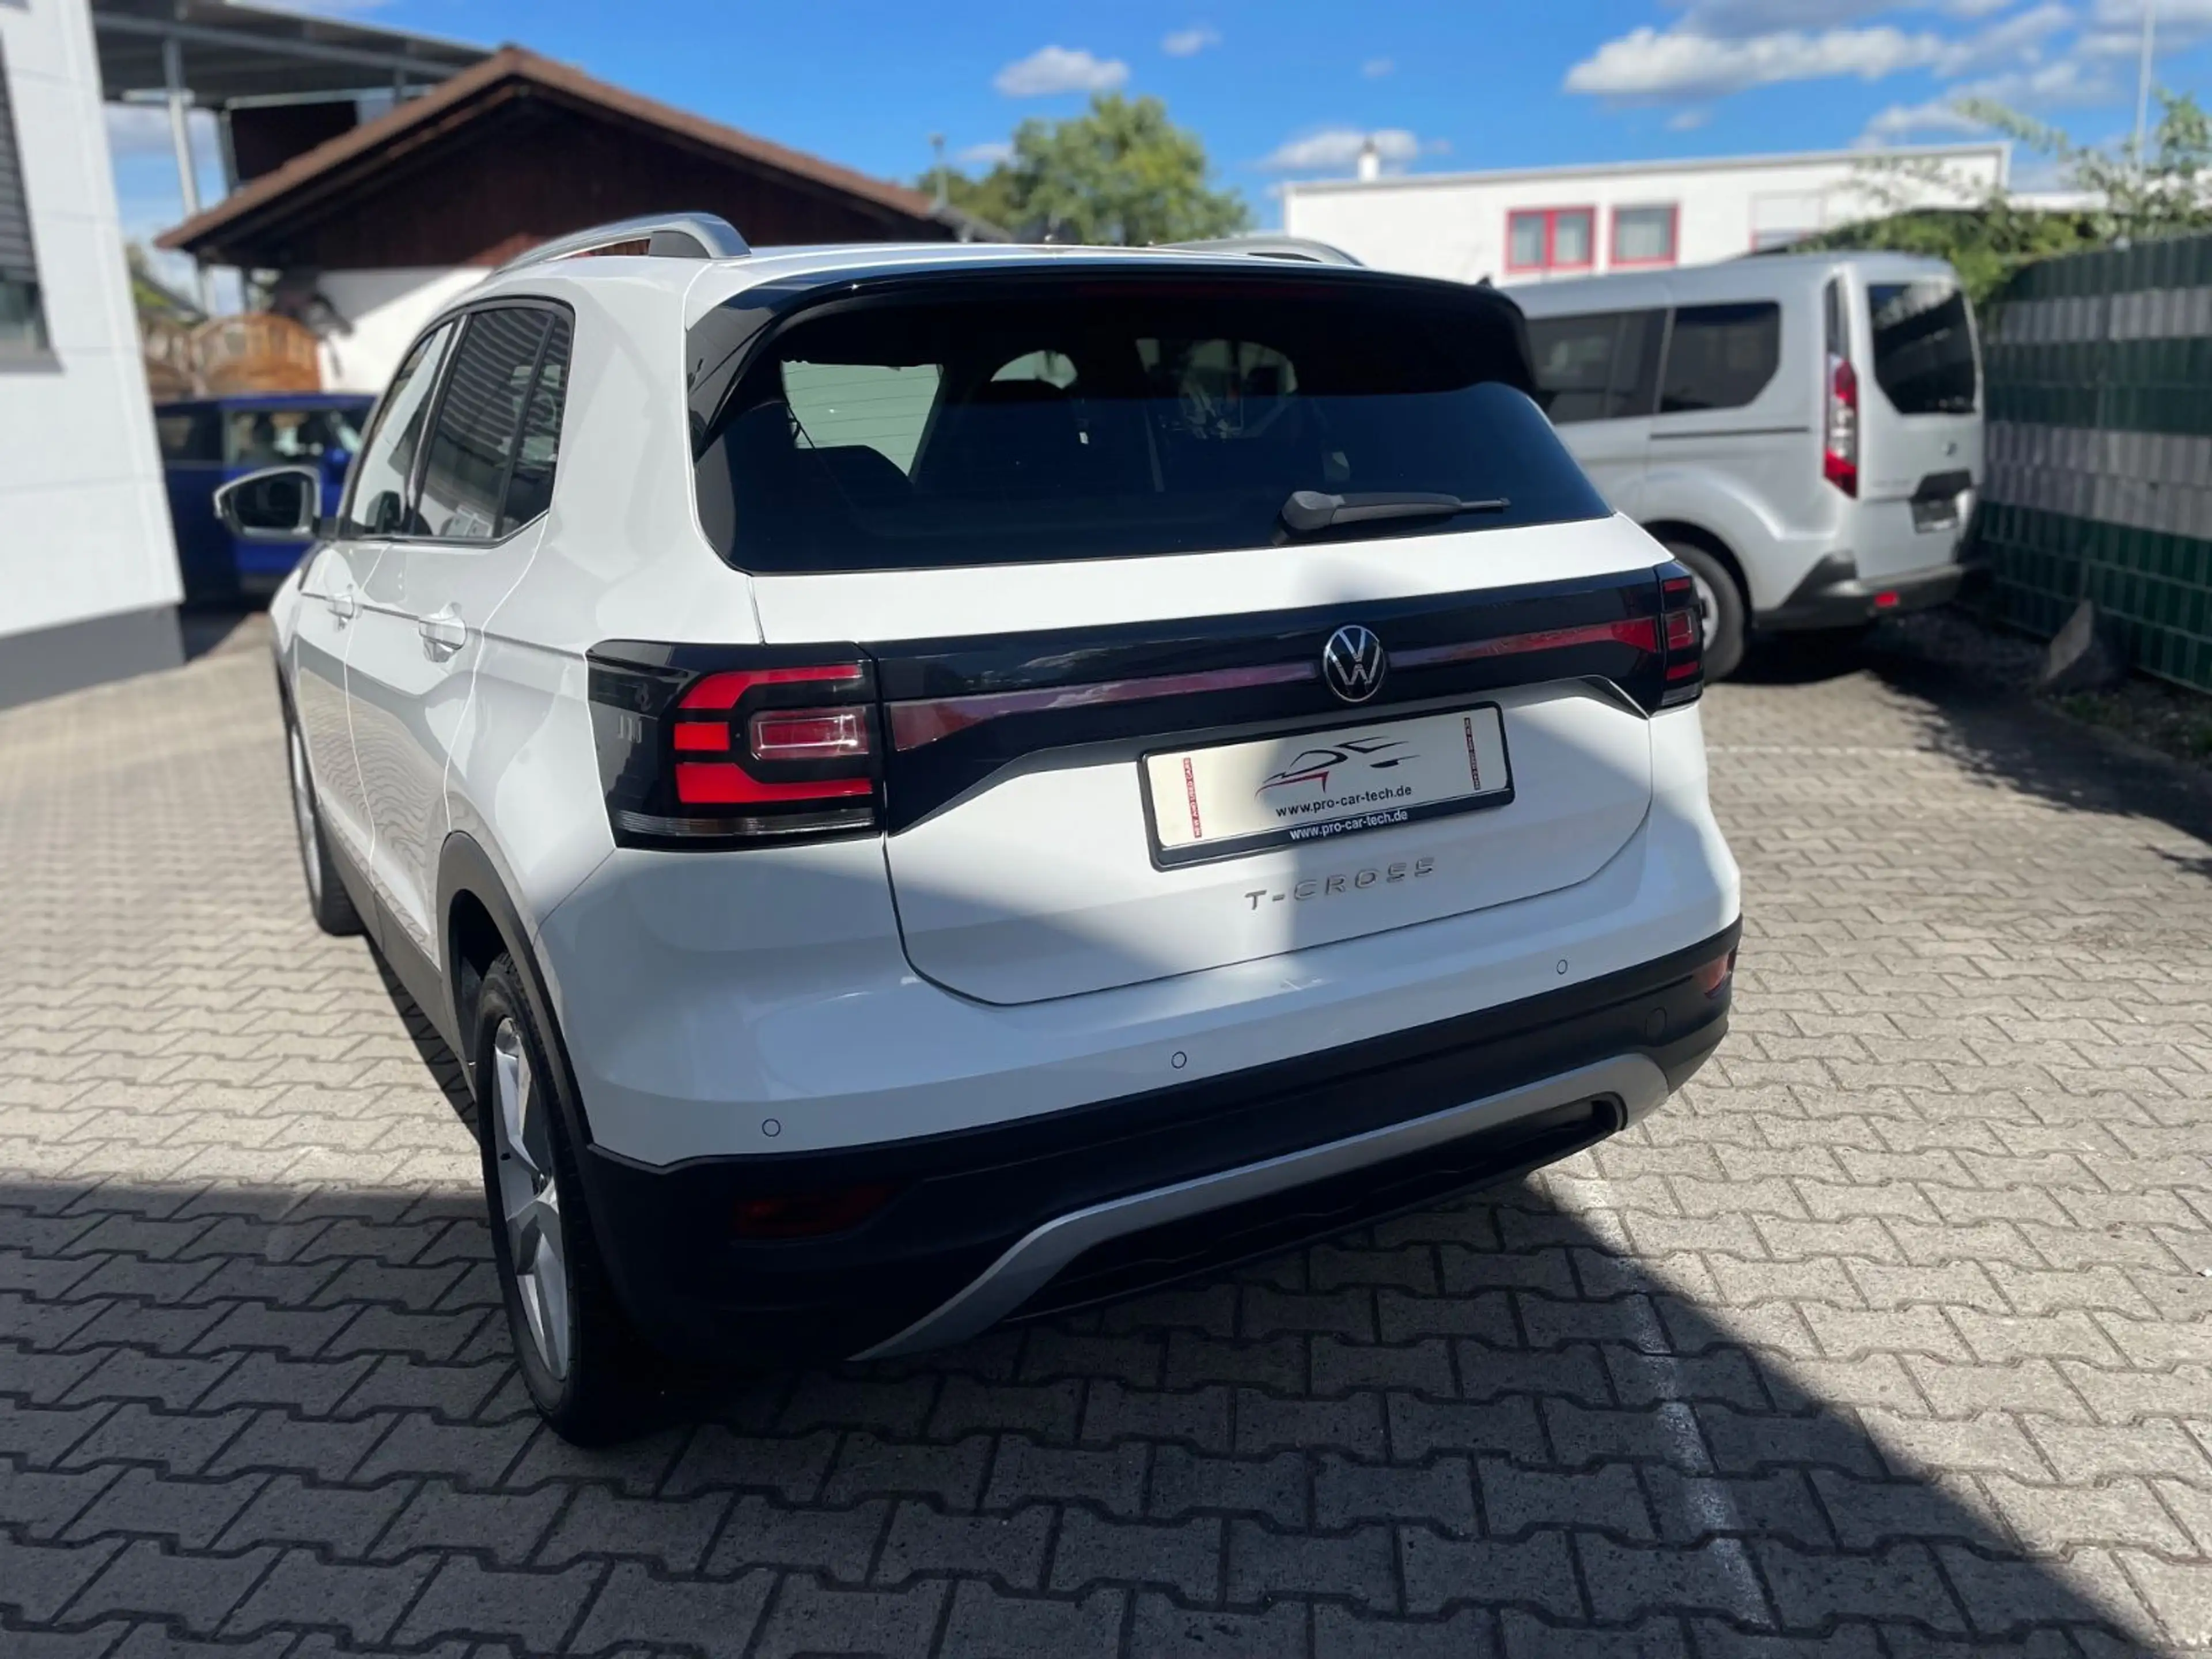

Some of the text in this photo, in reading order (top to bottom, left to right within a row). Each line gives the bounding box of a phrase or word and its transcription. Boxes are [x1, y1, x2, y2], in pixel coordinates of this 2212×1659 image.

[1325, 628, 1381, 685] VW
[1275, 785, 1412, 817] www.pro-car-tech.de
[1289, 810, 1408, 840] www.pro-car-tech.de
[1244, 857, 1435, 910] T-CROSS
